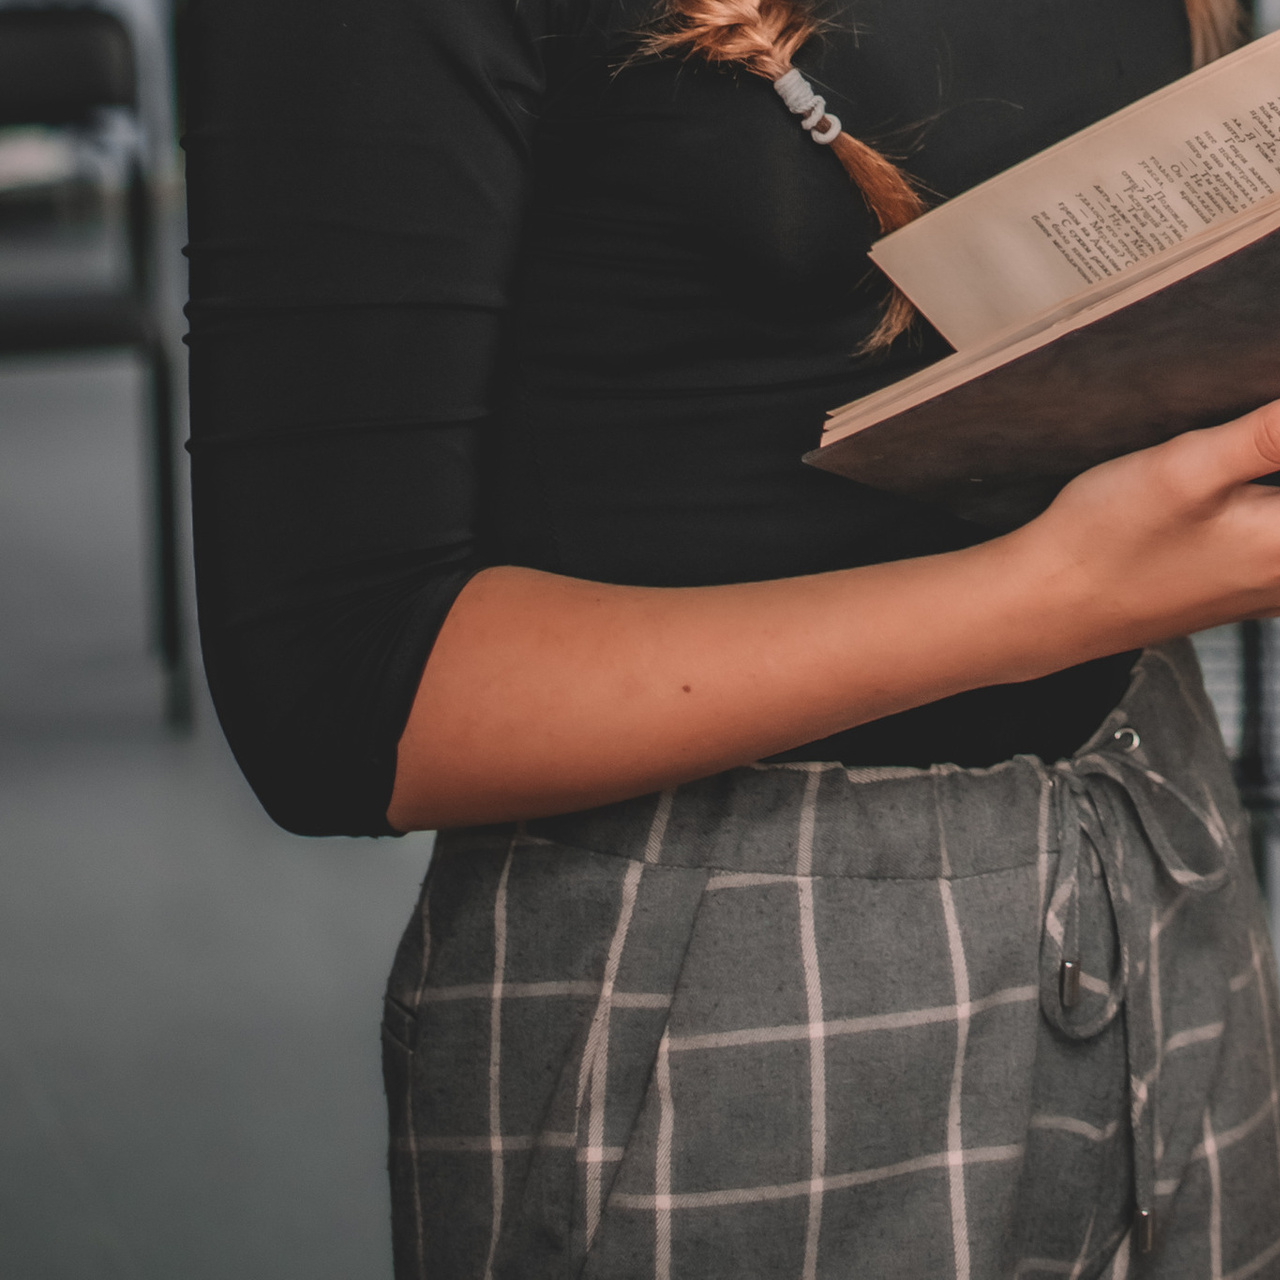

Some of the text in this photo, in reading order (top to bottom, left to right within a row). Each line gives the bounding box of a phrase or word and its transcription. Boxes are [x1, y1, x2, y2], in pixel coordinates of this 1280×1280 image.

[1221, 119, 1247, 144] ноте?
[1193, 135, 1209, 150] как
[1208, 152, 1225, 168] оно
[1202, 130, 1259, 193] нее посмотреть
[1222, 137, 1251, 165] Генри
[1253, 142, 1275, 164] тоже
[1092, 183, 1113, 203] дать
[1110, 203, 1131, 224] даже
[1118, 168, 1146, 195] отец?
[1149, 204, 1169, 223] хочу
[1148, 155, 1213, 225] только красный
[1182, 180, 1217, 217] поглядел
[1211, 172, 1241, 203] другое,
[1074, 191, 1107, 224] удалось
[1104, 224, 1119, 238] его
[1120, 186, 1163, 229] Гаснущий
[1124, 204, 1149, 227] Твой
[1050, 222, 1073, 245] было
[1067, 228, 1092, 254] сухим
[1087, 219, 1126, 259] Мерлин?
